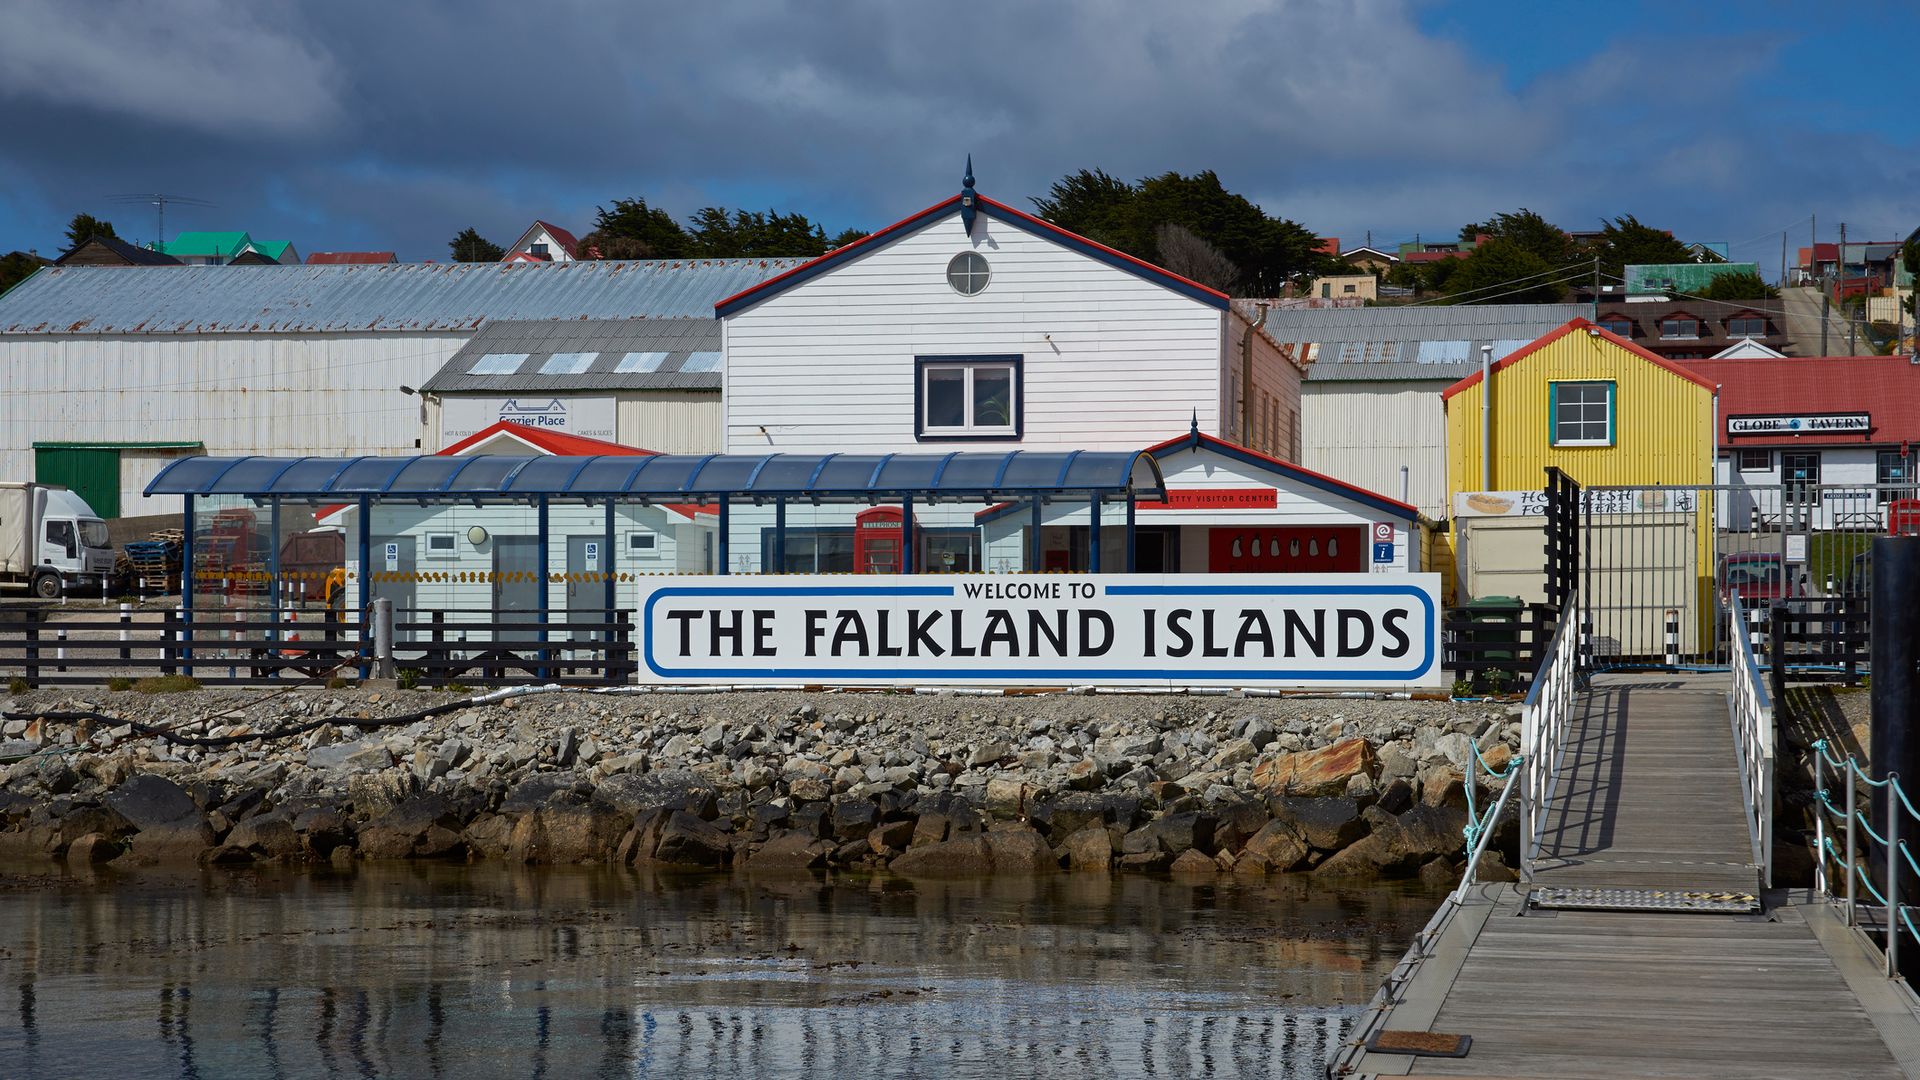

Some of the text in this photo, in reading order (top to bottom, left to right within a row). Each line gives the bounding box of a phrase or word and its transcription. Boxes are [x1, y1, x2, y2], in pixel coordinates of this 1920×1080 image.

[538, 415, 565, 426] Place
[1732, 417, 1864, 431] GLOBE TAVERN
[1170, 495, 1191, 503] ETTY
[1196, 495, 1234, 503] VISITOR
[1521, 490, 1632, 504] HO RESH
[963, 582, 1096, 600] WELCOME TO
[666, 608, 1410, 658] THE FALKLAND ISLANDS
